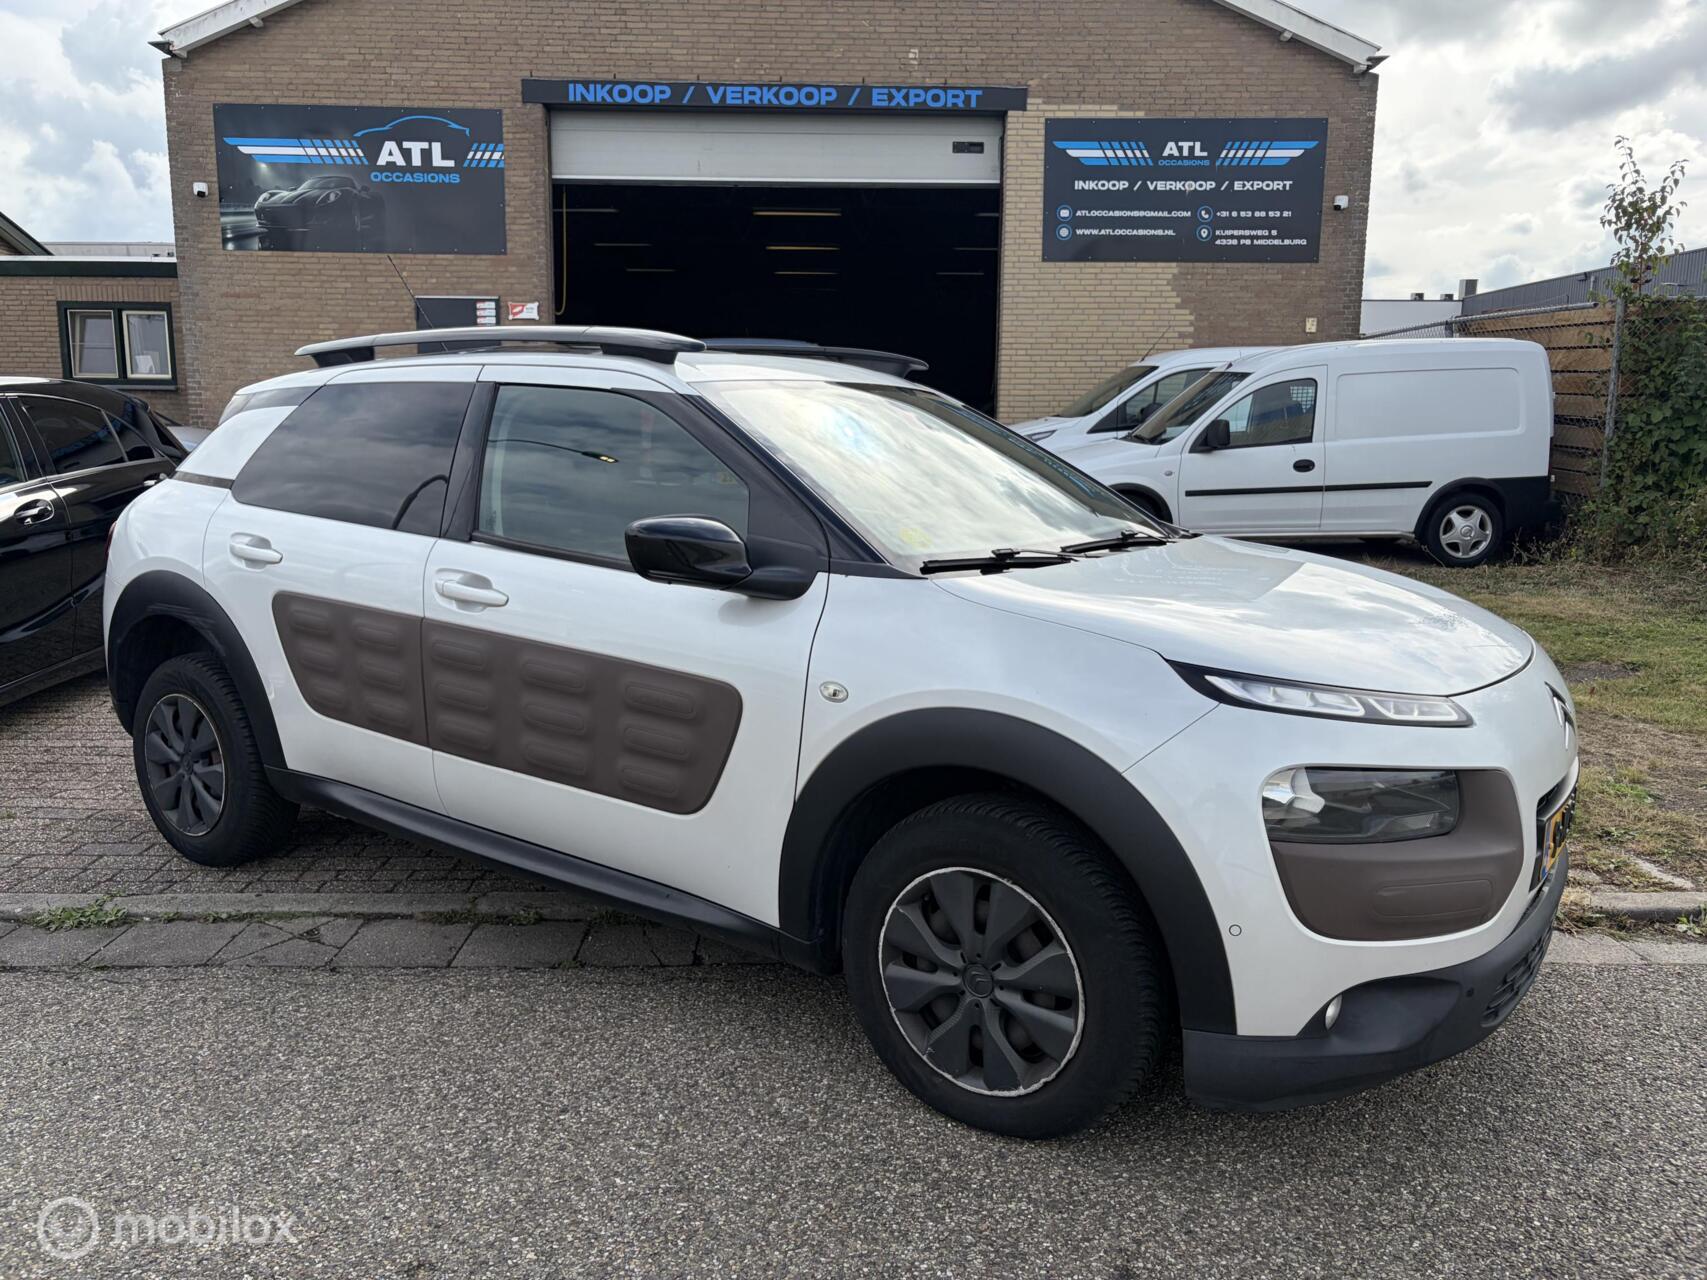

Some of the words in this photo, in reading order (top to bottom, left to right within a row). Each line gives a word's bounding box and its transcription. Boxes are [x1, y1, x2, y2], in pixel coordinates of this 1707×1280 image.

[568, 83, 671, 103] INKOOP
[706, 86, 837, 106] VERKOOP
[871, 88, 983, 108] EXPORT
[376, 140, 455, 167] ATL
[1162, 141, 1208, 157] ATL
[1158, 159, 1210, 167] OCCASIONS
[370, 171, 460, 184] OCCASIONS
[1074, 180, 1129, 190] INKOOP
[1147, 181, 1216, 191] VERKOOP
[1233, 181, 1293, 191] EXPORT
